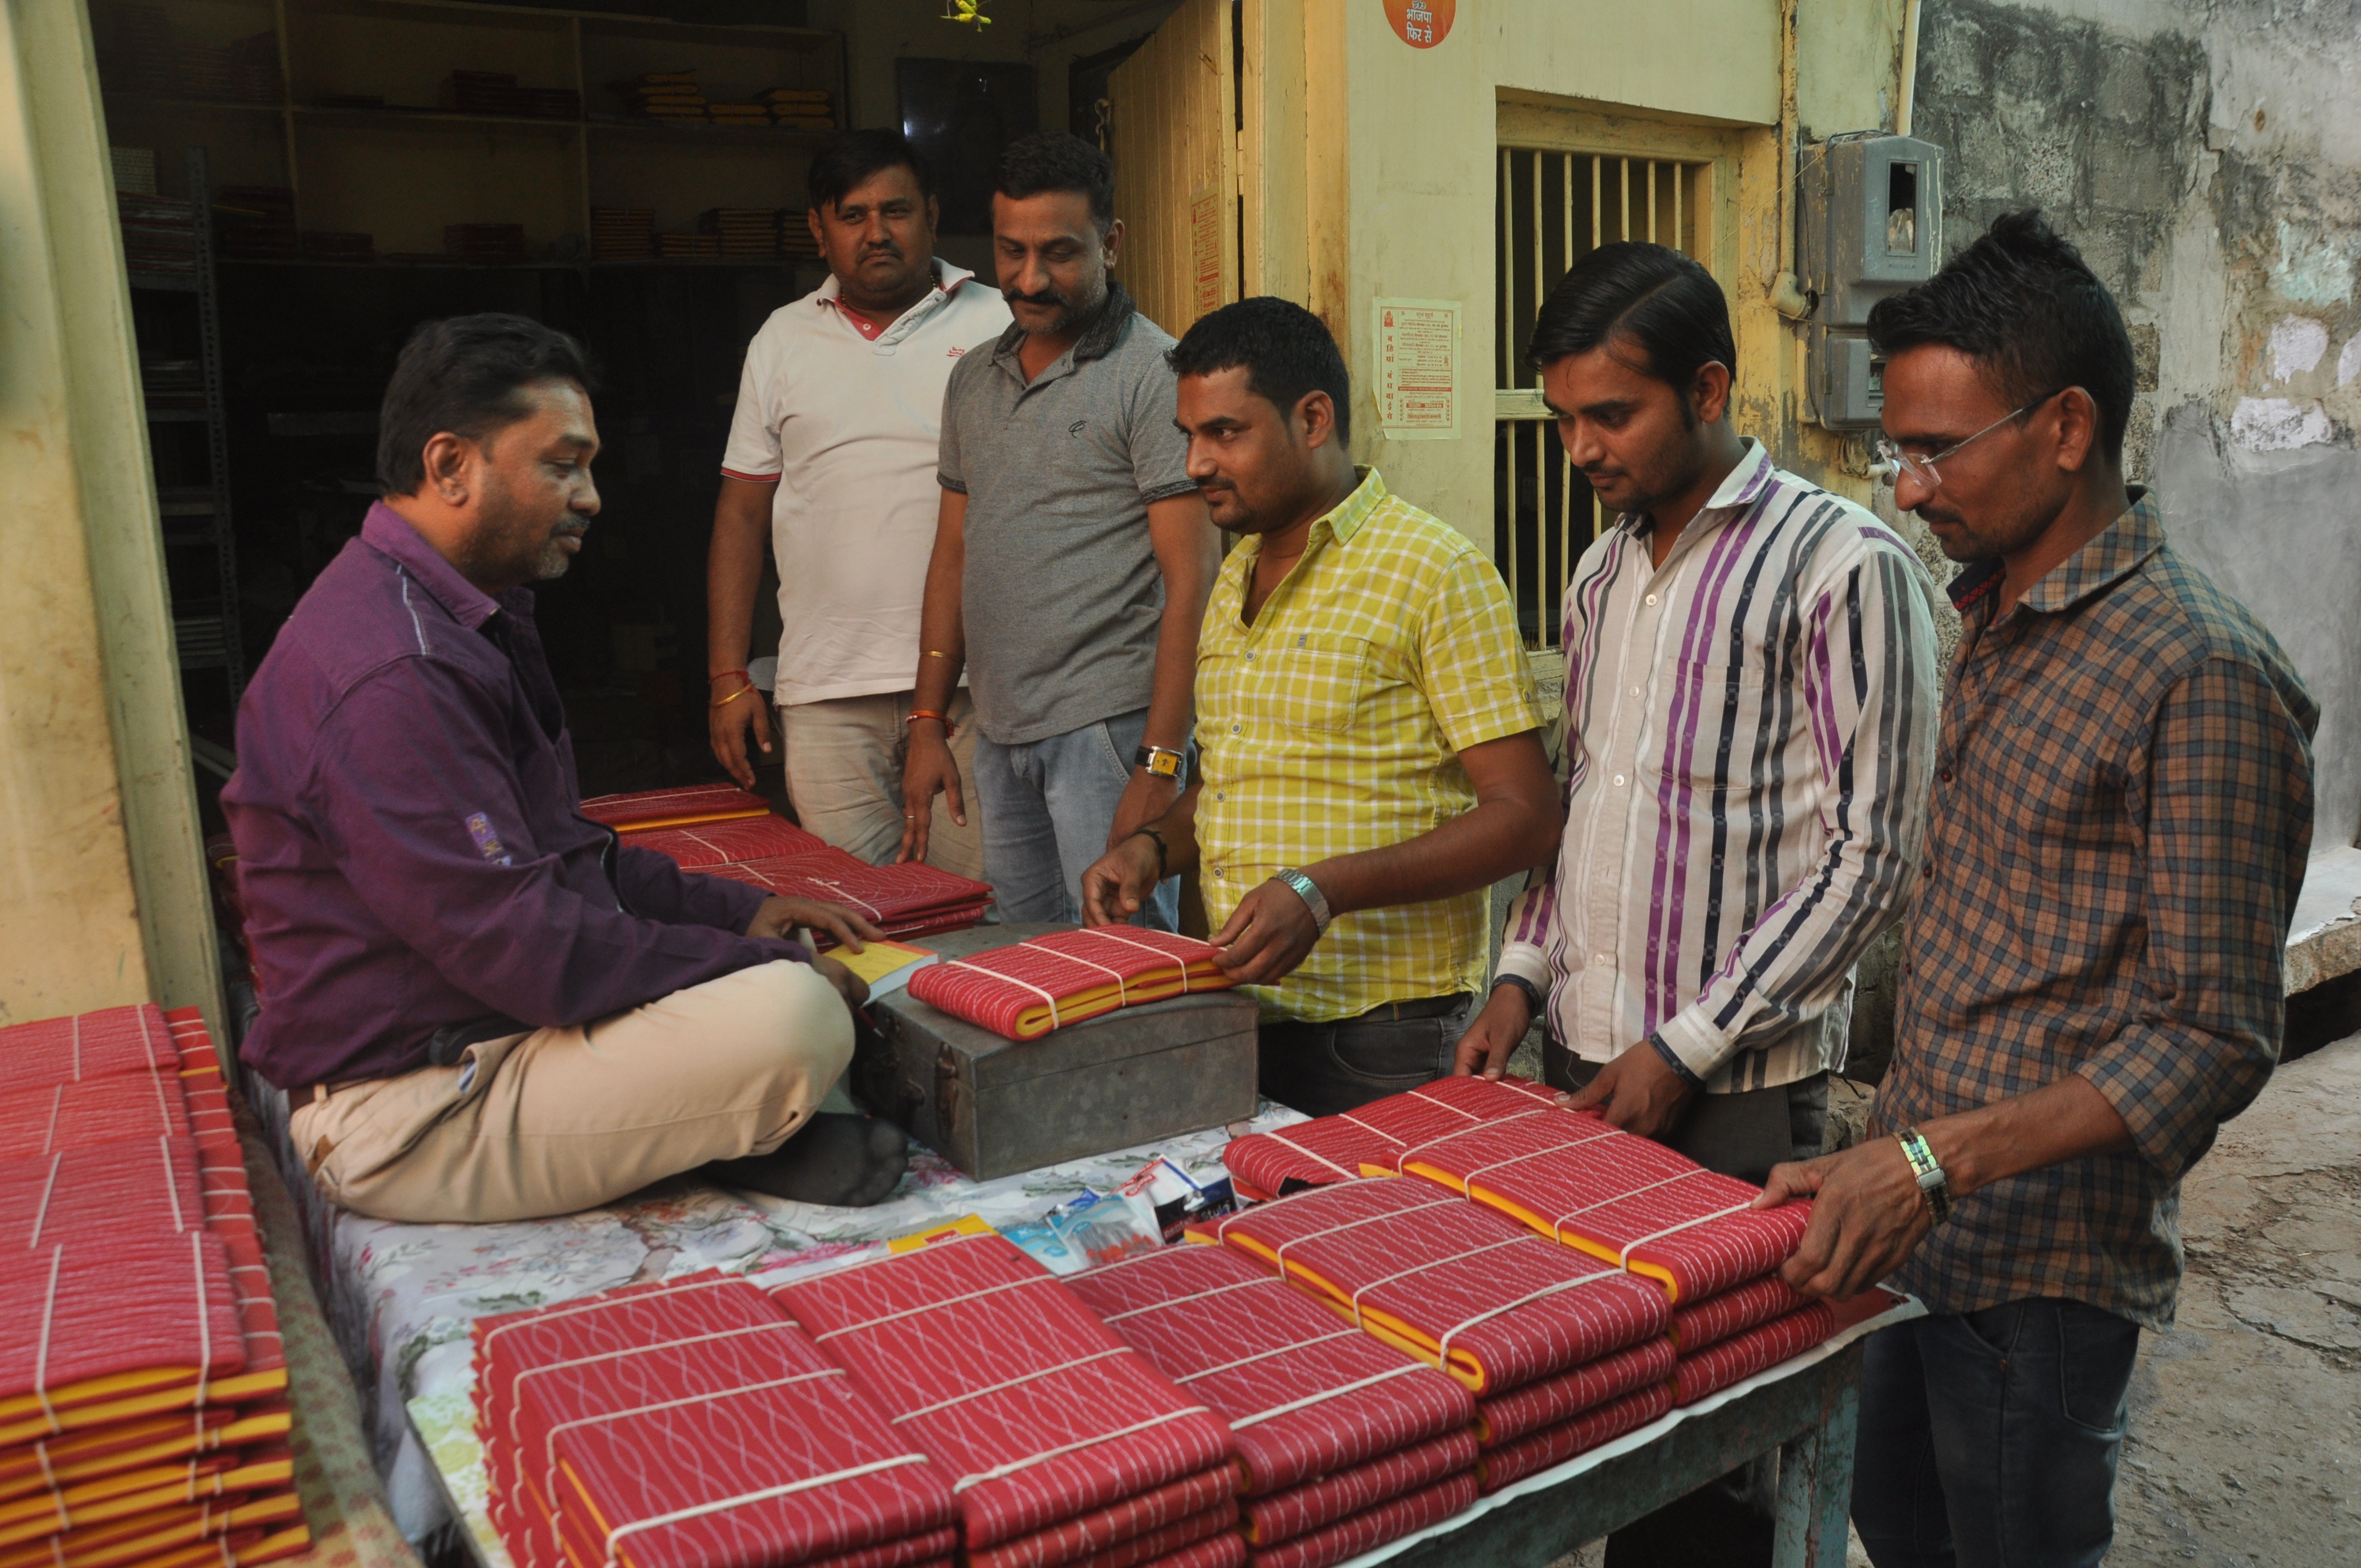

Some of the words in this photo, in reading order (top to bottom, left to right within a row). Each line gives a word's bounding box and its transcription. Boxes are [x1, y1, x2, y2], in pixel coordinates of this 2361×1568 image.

[1406, 8, 1432, 24] भाजपा
[1406, 21, 1422, 41] फिर
[1424, 25, 1432, 43] से
